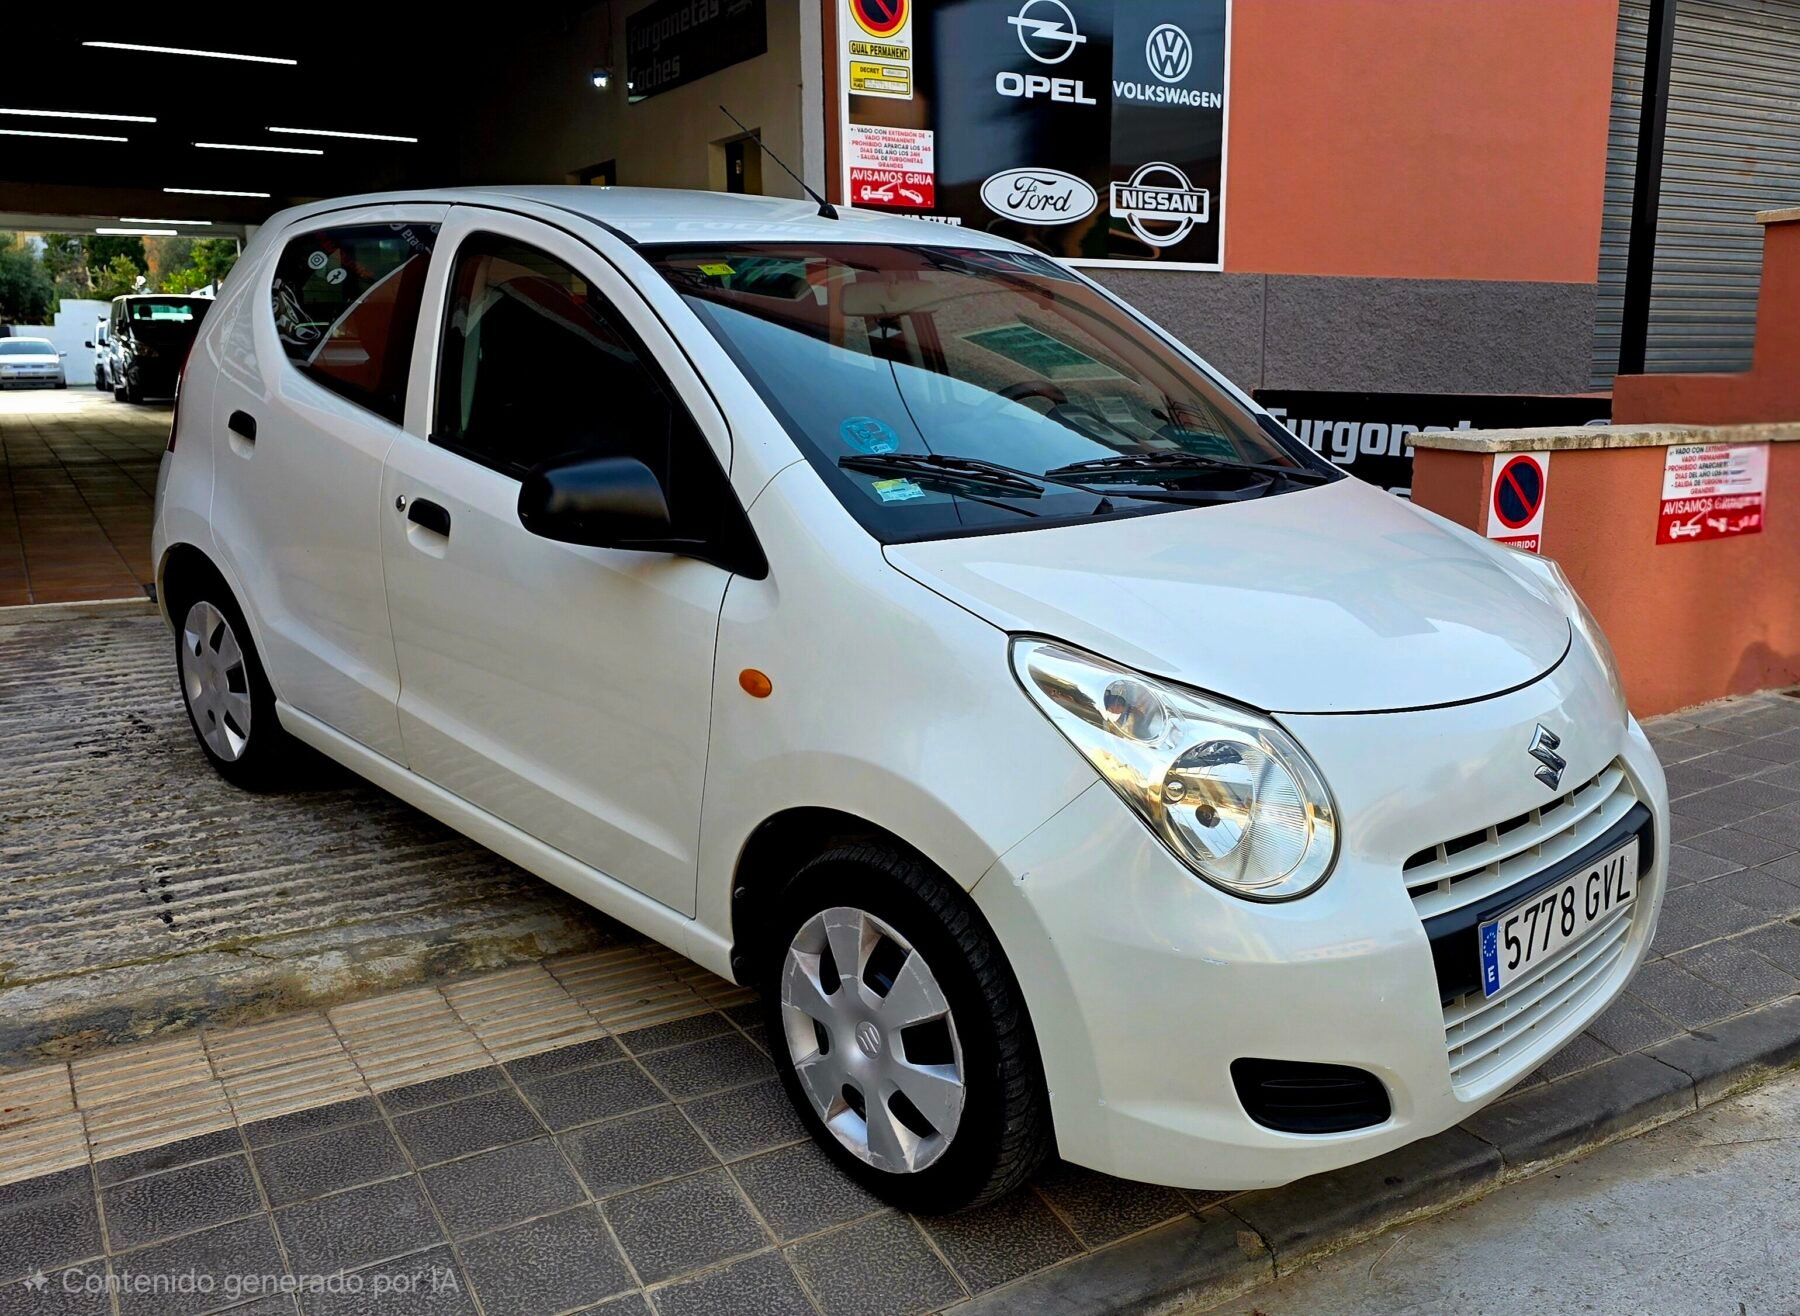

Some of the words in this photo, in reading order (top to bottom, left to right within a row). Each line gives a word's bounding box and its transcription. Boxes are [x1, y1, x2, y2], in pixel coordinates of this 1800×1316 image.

[851, 42, 868, 55] GUAL
[870, 45, 907, 60] PERMANENT
[860, 66, 880, 74] DECRET
[996, 71, 1097, 105] OPEL
[1112, 80, 1222, 109] VOLKSWAGEN
[889, 156, 923, 164] FURGONETAS
[852, 169, 902, 183] AVISAMOS
[906, 173, 933, 185] GRUA
[1007, 177, 1073, 212] Ford
[1122, 190, 1198, 213] NISSAN
[1663, 498, 1712, 515] AVISAMOS
[1504, 885, 1575, 970] 5778
[1585, 855, 1631, 922] GVL
[1488, 965, 1495, 983] E
